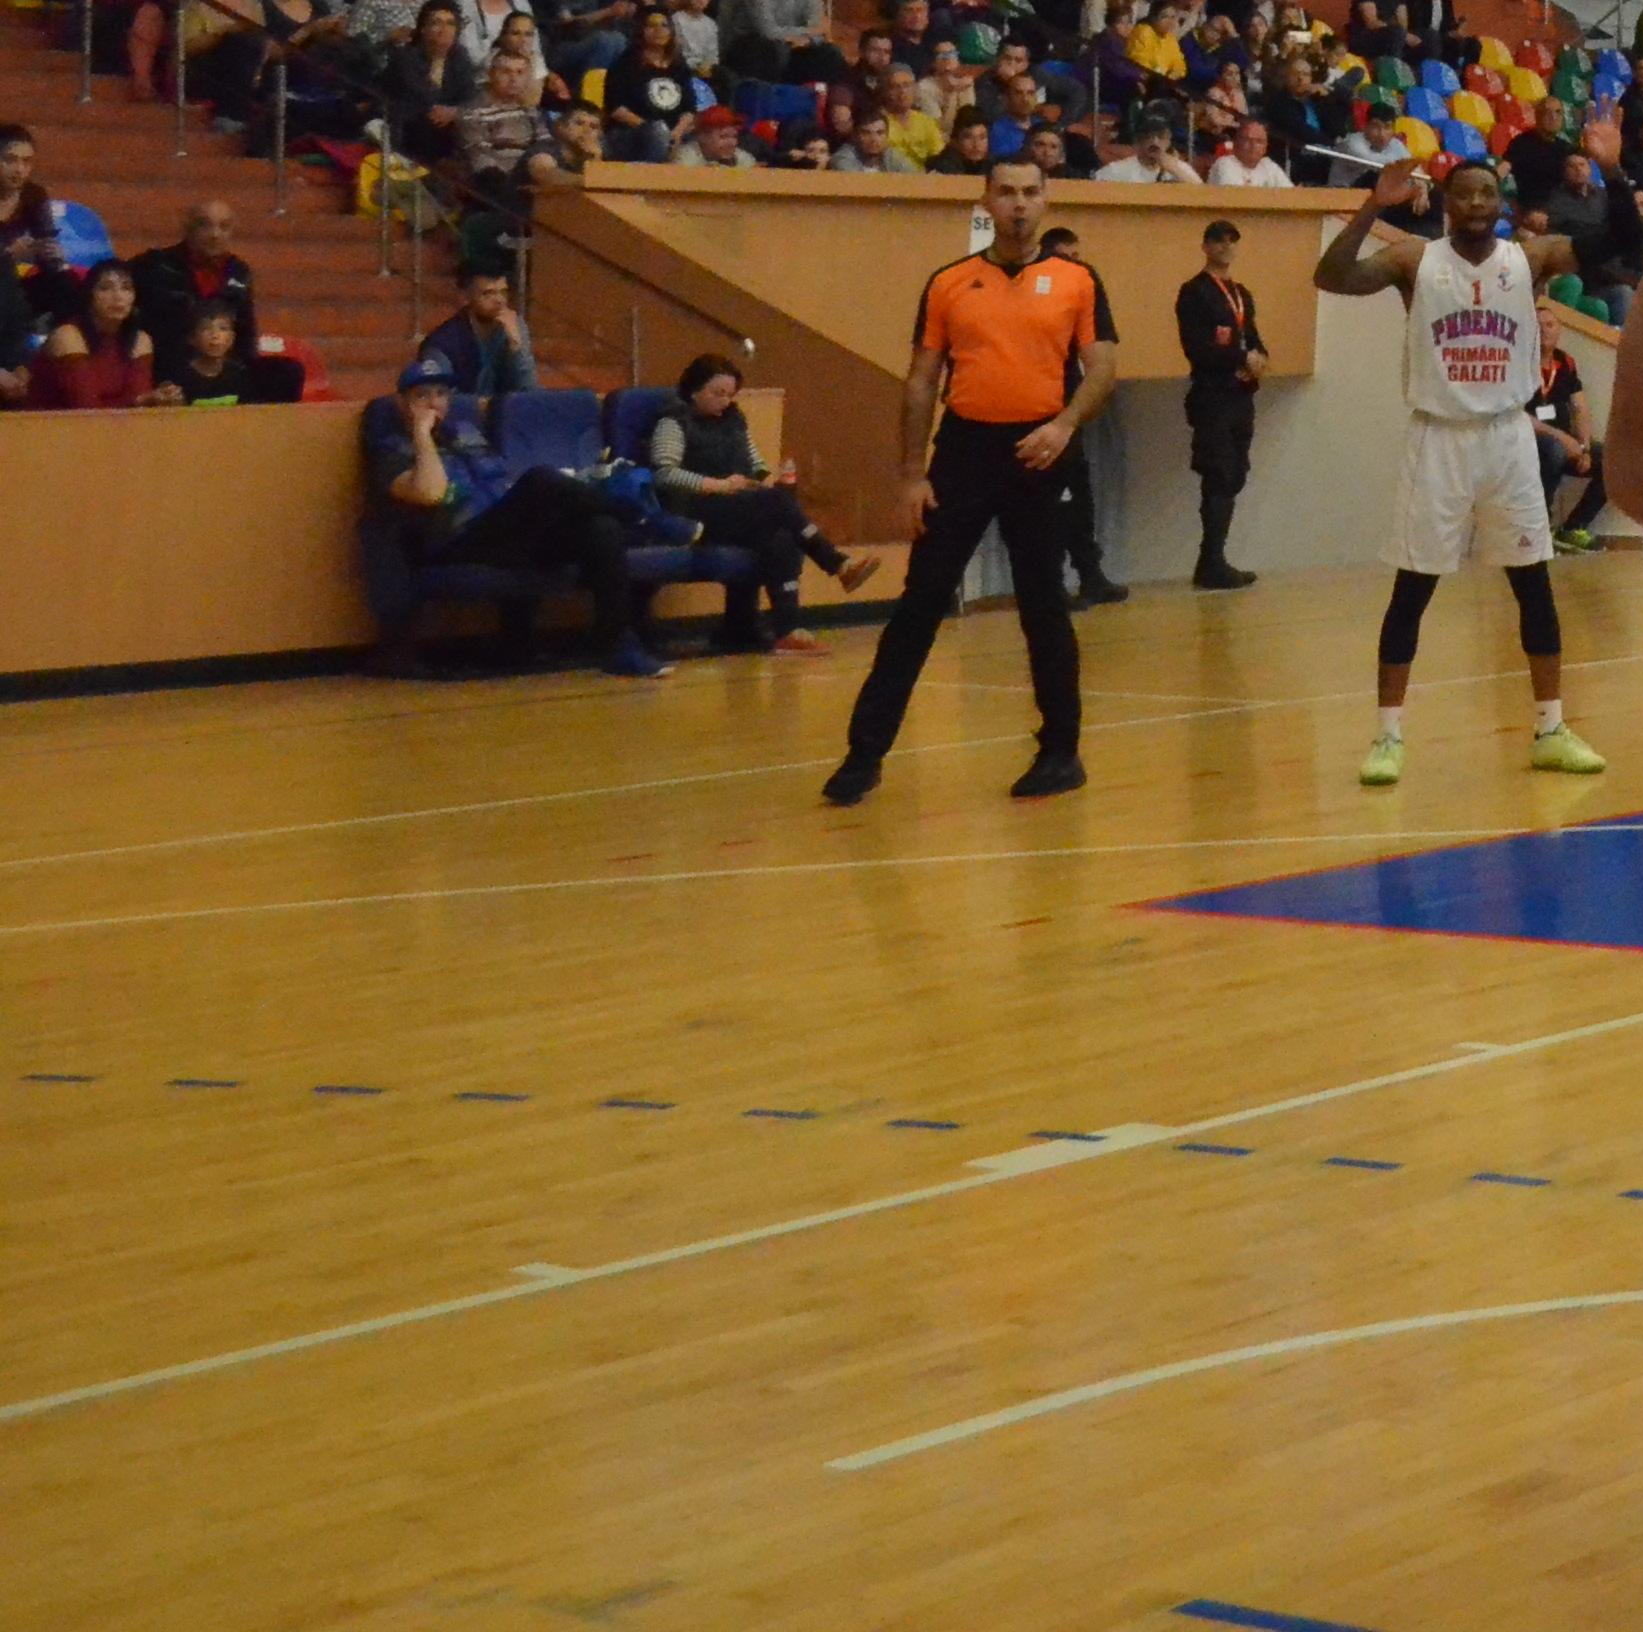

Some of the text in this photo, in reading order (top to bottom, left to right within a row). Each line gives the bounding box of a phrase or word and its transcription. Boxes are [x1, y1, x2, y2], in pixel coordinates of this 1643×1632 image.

[973, 215, 992, 231] SE
[1471, 279, 1483, 306] 1
[1430, 308, 1519, 347] PHOENIX
